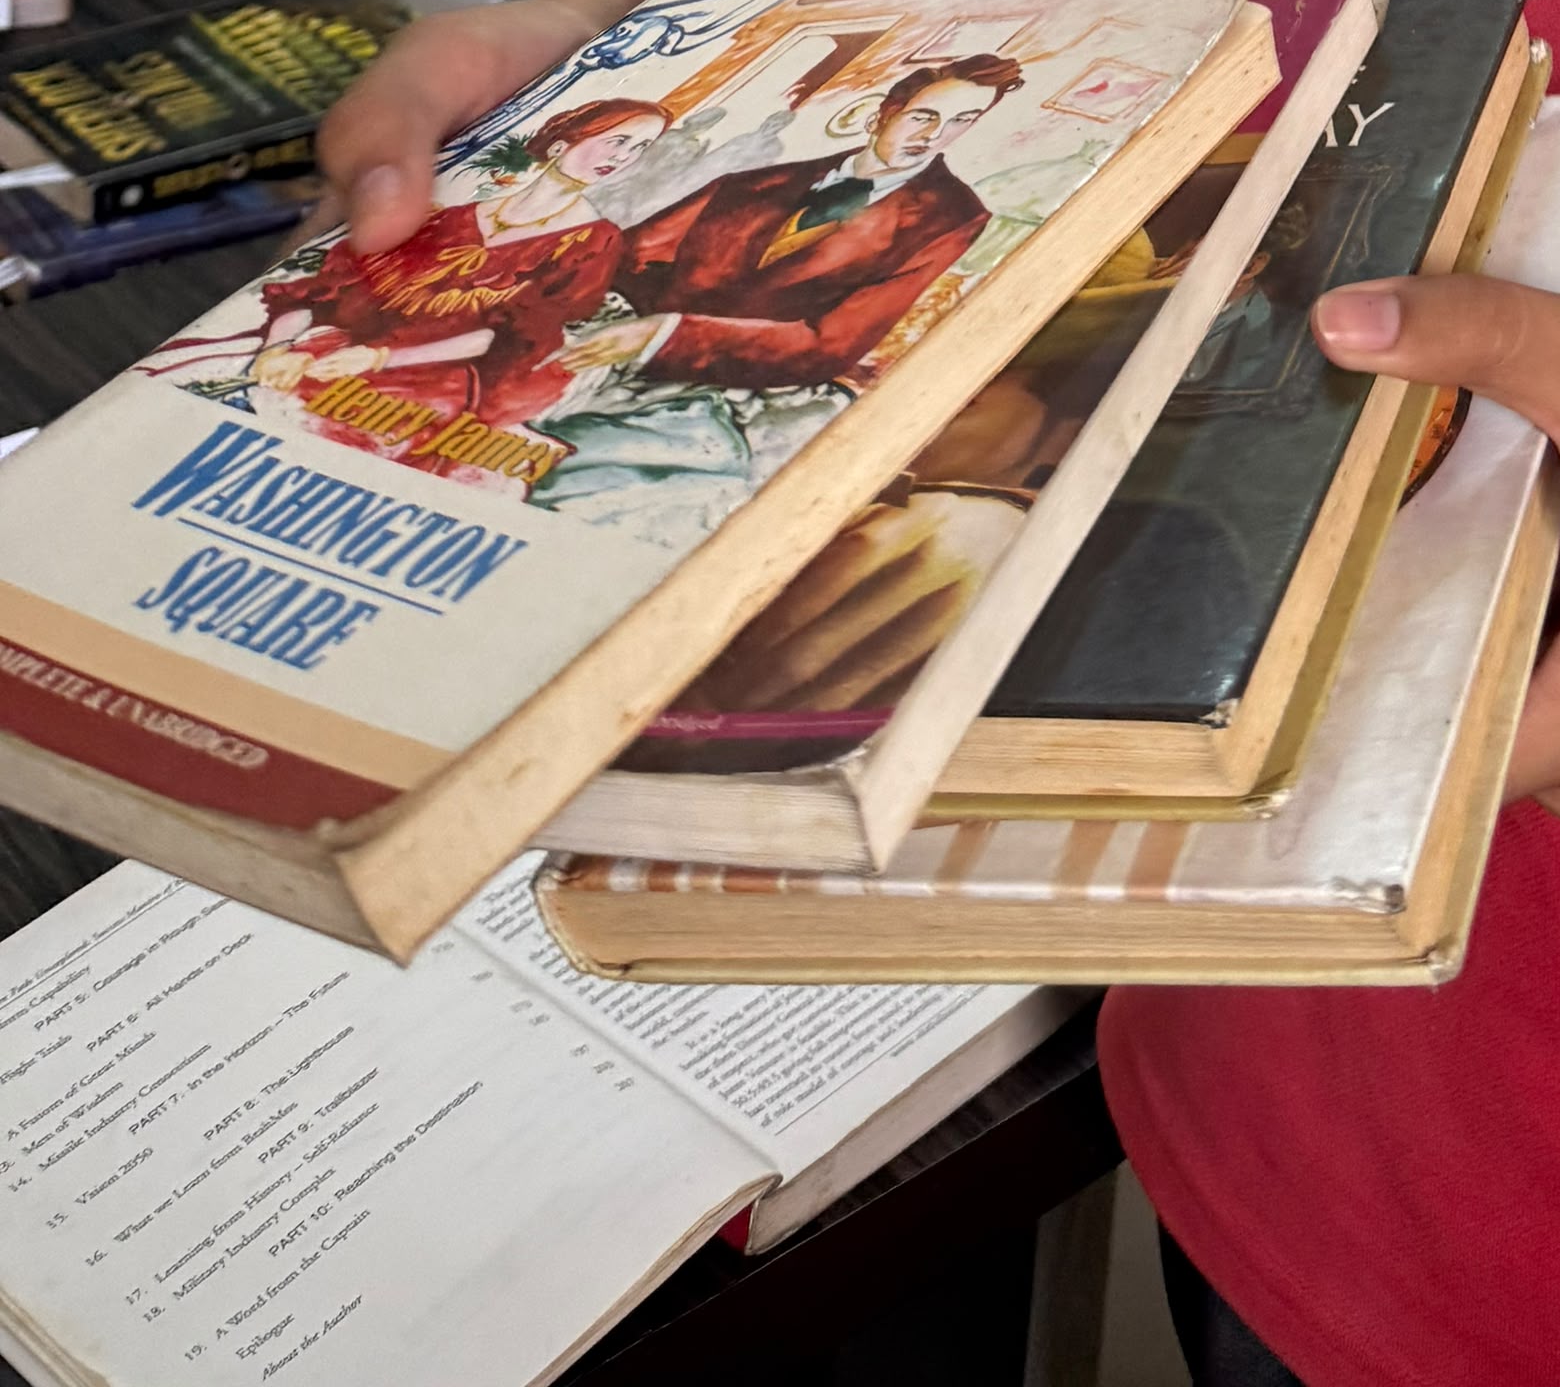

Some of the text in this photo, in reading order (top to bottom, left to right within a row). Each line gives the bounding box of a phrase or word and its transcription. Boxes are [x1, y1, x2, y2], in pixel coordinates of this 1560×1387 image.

[305, 376, 567, 483] Henry James
[131, 421, 528, 602] WASHINGTON
[135, 545, 381, 671] SQUARE
[28, 965, 91, 1009] Capability
[33, 1001, 73, 1032] PART
[92, 952, 147, 993] Courage
[85, 1021, 126, 1052] PART
[145, 994, 164, 1011] All
[161, 966, 205, 998] Hands
[220, 933, 252, 957] Deck
[128, 1100, 168, 1136] PART
[201, 1062, 225, 1080] the
[223, 1025, 274, 1063] Horizon
[281, 999, 310, 1018] The
[308, 971, 350, 1001] Future
[20, 1132, 56, 1155] Men
[83, 1096, 137, 1139] Industry
[202, 1106, 243, 1141] PART
[259, 1075, 292, 1095] The
[257, 1130, 297, 1164] PART
[74, 1174, 121, 1205] Vision
[268, 1219, 308, 1258] PART
[333, 1151, 397, 1202] Reaching
[393, 1134, 417, 1153] the
[414, 1081, 484, 1136] Destination
[125, 1287, 148, 1306] 17.
[154, 1235, 216, 1284] Learning
[242, 1170, 292, 1211] History
[172, 1256, 226, 1301] Military
[223, 1211, 280, 1259] Industry
[184, 1209, 371, 1361] 19. A Word from the Captain
[235, 1313, 295, 1360] Epilogue
[262, 1294, 362, 1382] About the Author
